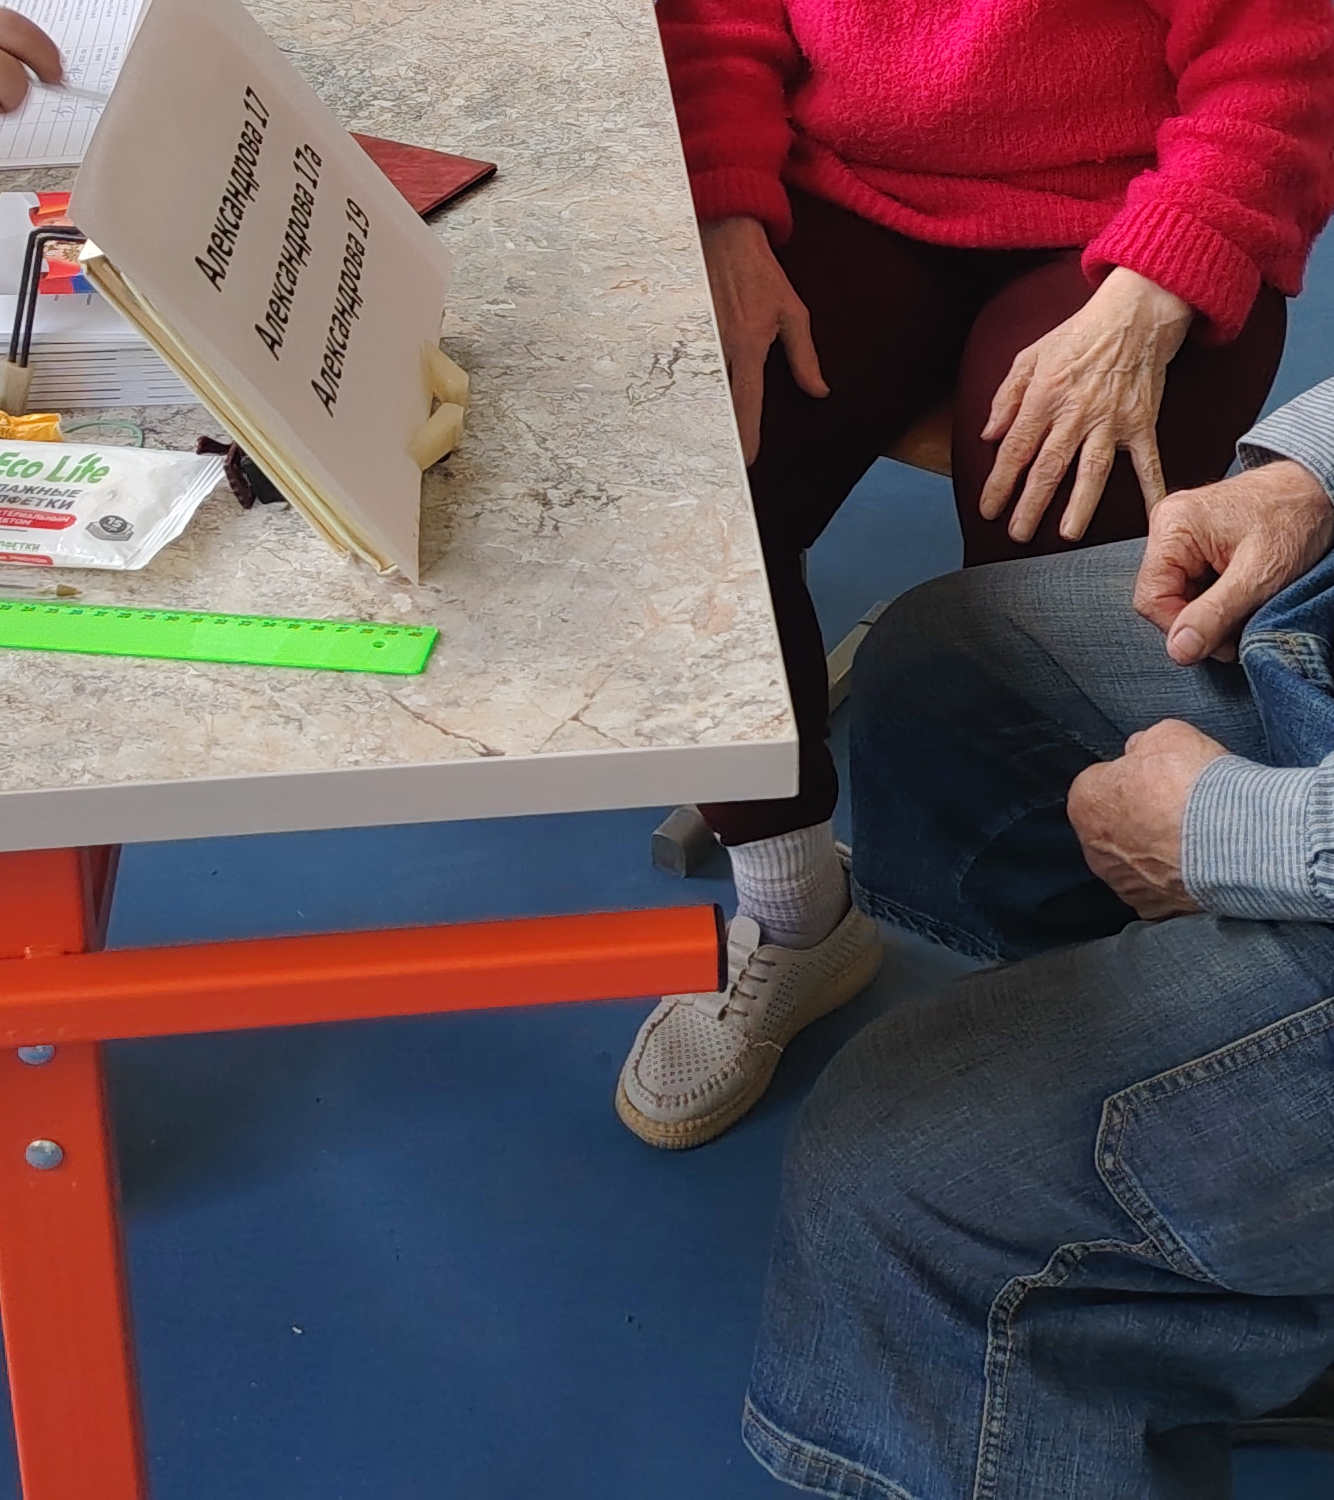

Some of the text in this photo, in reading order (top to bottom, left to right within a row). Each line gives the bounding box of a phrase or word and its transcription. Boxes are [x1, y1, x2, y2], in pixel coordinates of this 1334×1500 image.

[194, 85, 270, 293] Александрова 17
[254, 143, 323, 362] Александрова 17а
[310, 198, 370, 418] Александрова 19
[43, 452, 111, 484] Life
